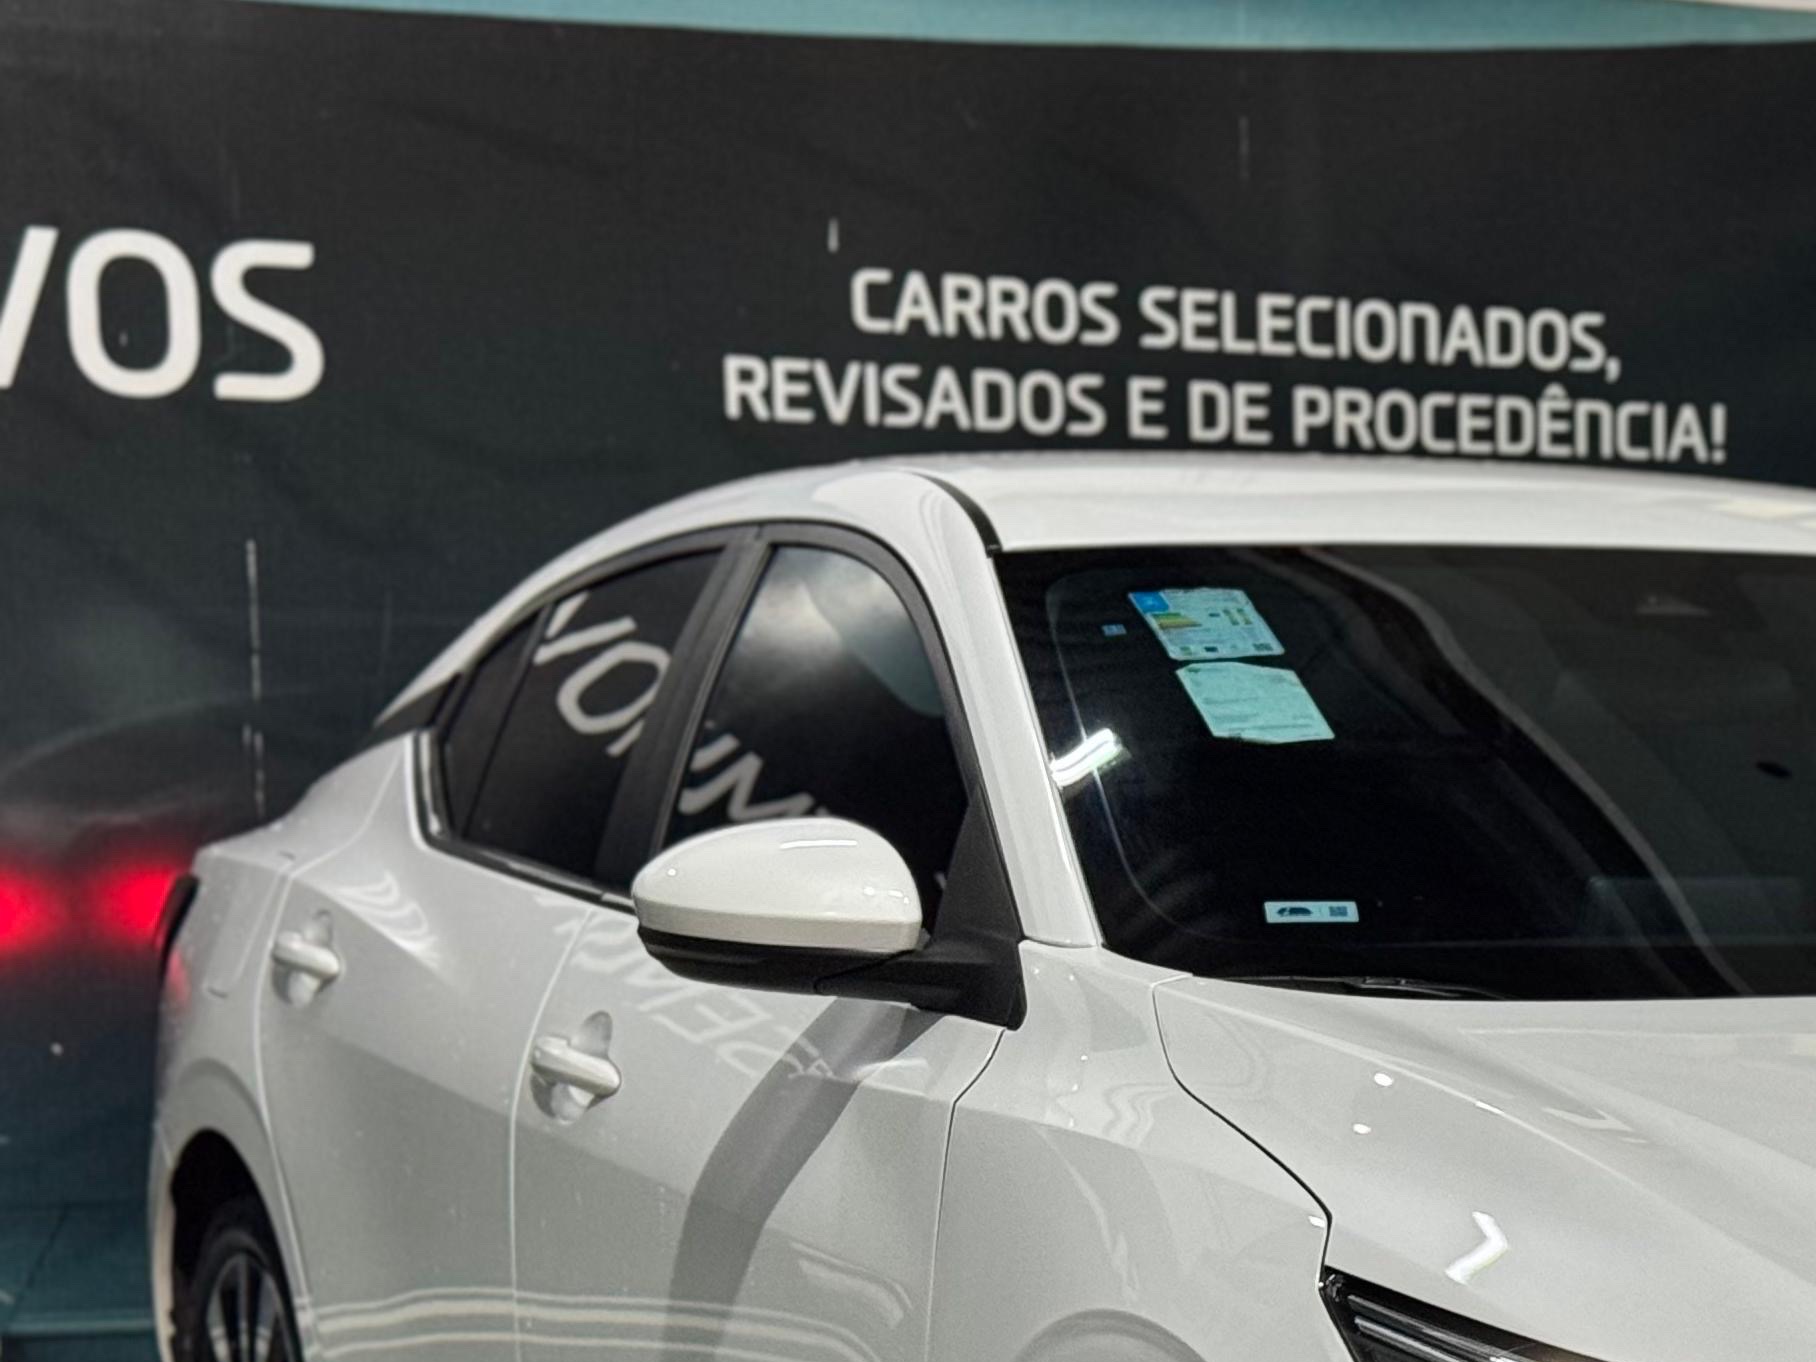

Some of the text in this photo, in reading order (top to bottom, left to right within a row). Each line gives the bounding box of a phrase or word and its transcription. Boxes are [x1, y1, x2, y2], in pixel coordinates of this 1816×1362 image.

[850, 267, 1622, 384] CARROS SELECIONADOS,
[722, 353, 1728, 466] REVISADOS E DE PROCEDÊNCIA!
